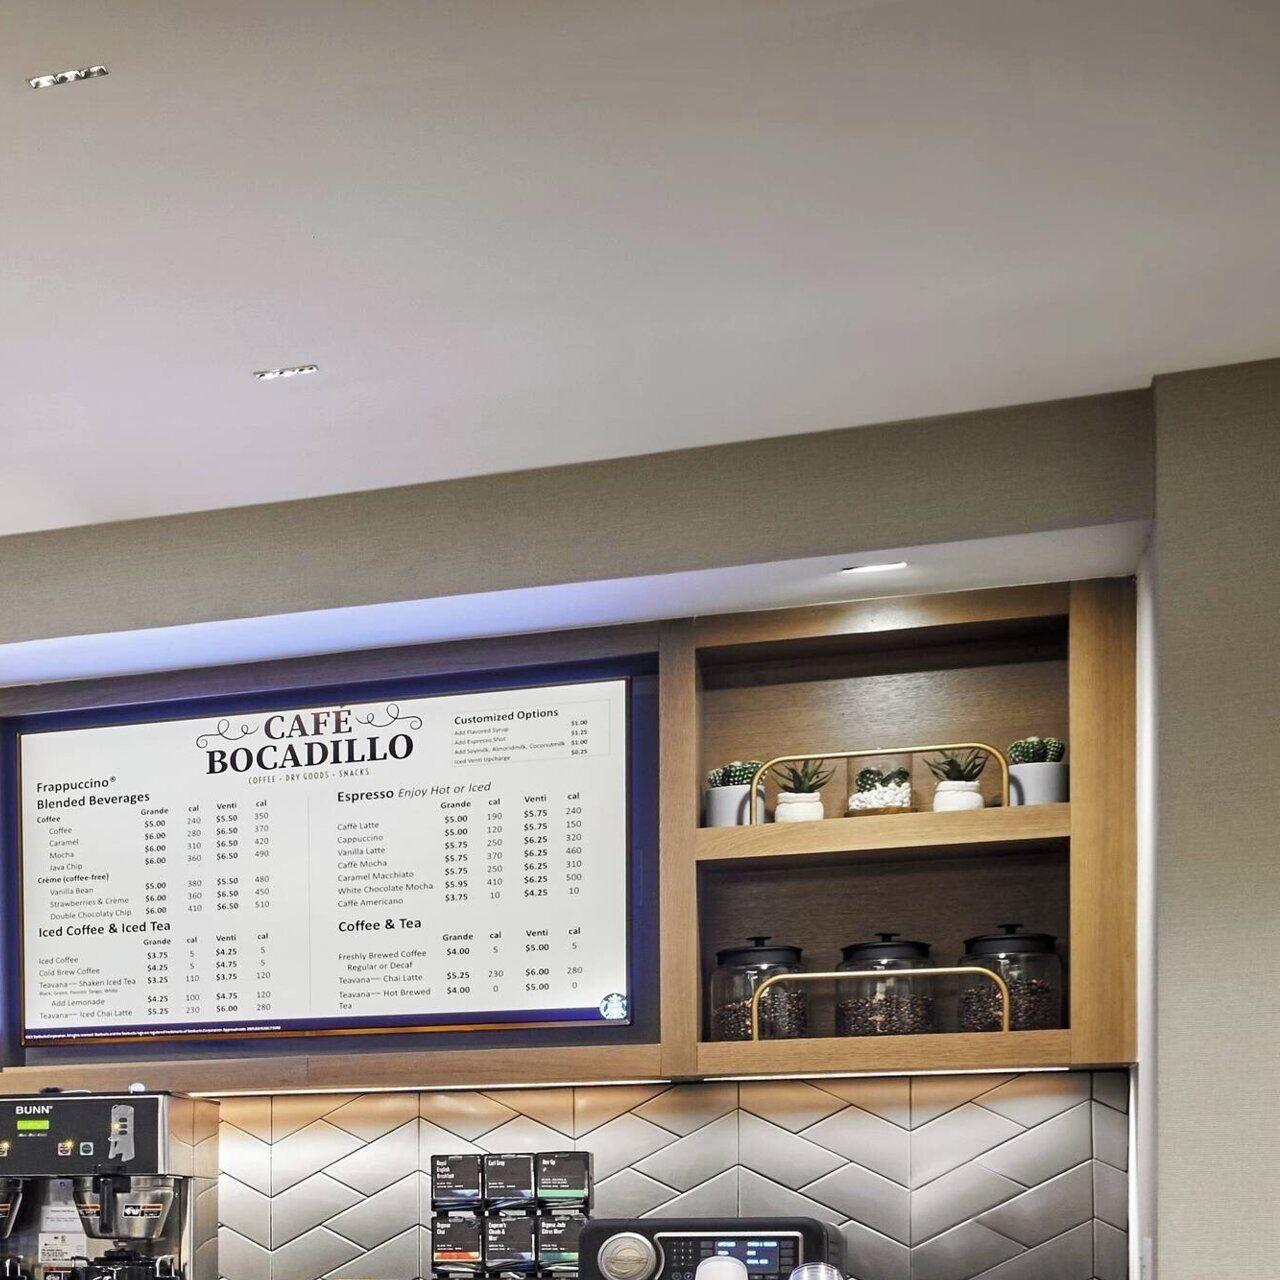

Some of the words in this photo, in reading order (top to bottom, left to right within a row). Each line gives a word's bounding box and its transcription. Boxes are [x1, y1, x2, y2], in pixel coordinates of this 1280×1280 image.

[264, 704, 352, 740] CAFÉ
[455, 711, 514, 725] Customized
[517, 709, 558, 721] Options
[206, 733, 413, 775] BOCADILLO
[248, 775, 275, 784] COFFEE
[286, 773, 300, 782] DRY
[303, 771, 329, 780] GOODS
[339, 768, 370, 778] SNACKS
[338, 790, 396, 804] Espresso
[399, 788, 428, 799] Enjoy
[431, 786, 450, 795] Hot
[469, 781, 491, 792] Iced
[38, 796, 85, 810] Blended
[89, 793, 150, 806] Beverages
[441, 800, 471, 809] Grande
[525, 794, 546, 803] Venti
[568, 792, 579, 800] cal
[37, 815, 60, 824] Coffee
[145, 820, 165, 828] $5.00
[216, 815, 238, 823] $5.50
[255, 812, 269, 820] 350
[445, 815, 468, 824] $5.00
[488, 812, 502, 821] 190
[524, 809, 547, 818] $5.75
[566, 807, 581, 815] 240
[50, 838, 78, 847] Caramel
[338, 835, 383, 844] Cappuccino
[524, 835, 547, 845] $6.25
[567, 833, 581, 841] 320
[338, 848, 363, 856] Vanilla
[63, 872, 109, 882] (coffee-free)
[338, 873, 370, 882] Caramel
[50, 888, 73, 896] Vanilla
[364, 885, 403, 893] Chocolate
[51, 900, 95, 908] Strawberries
[51, 912, 76, 920] Double
[39, 926, 62, 937] Iced
[67, 924, 104, 936] Coffee
[109, 923, 118, 934] &
[122, 921, 146, 933] Iced
[150, 921, 170, 931] Tea
[339, 919, 380, 932] Coffee
[385, 918, 395, 930] &
[399, 918, 421, 929] Tea
[369, 951, 399, 959] Brewed
[401, 949, 426, 957] Coffee
[447, 948, 470, 956] $4.00
[526, 943, 549, 952] $5.00
[348, 964, 377, 972] Regular
[390, 961, 412, 969] Decaf
[15, 1105, 50, 1115] BUNN
